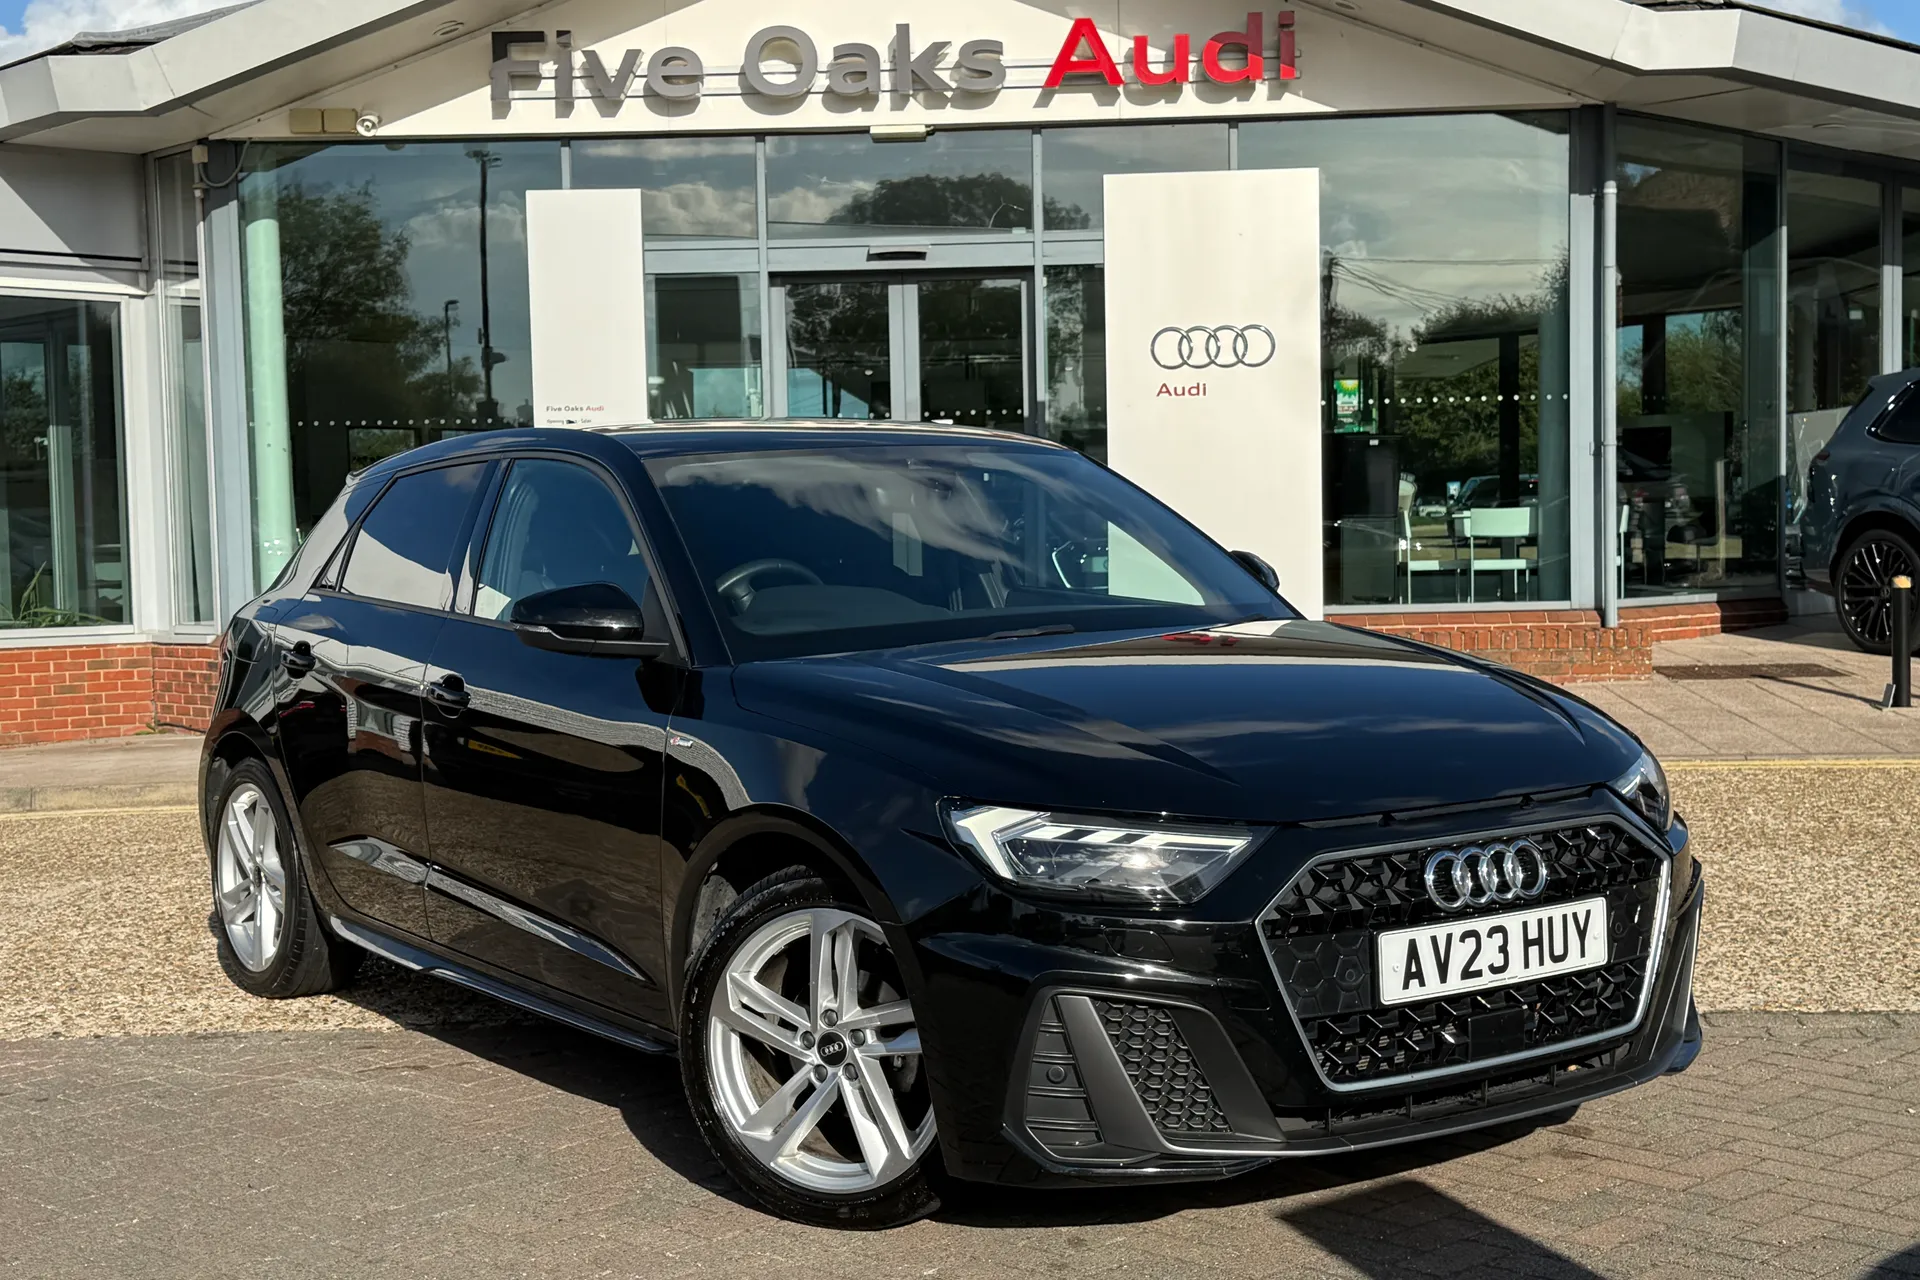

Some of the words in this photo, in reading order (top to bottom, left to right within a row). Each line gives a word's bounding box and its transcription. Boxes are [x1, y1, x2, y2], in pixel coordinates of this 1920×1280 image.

[491, 30, 703, 100] Five
[744, 23, 1006, 96] Oaks
[1043, 11, 1296, 88] Audi
[1156, 382, 1206, 397] Audi
[1402, 924, 1510, 991] AV23
[1521, 908, 1592, 970] HUY
